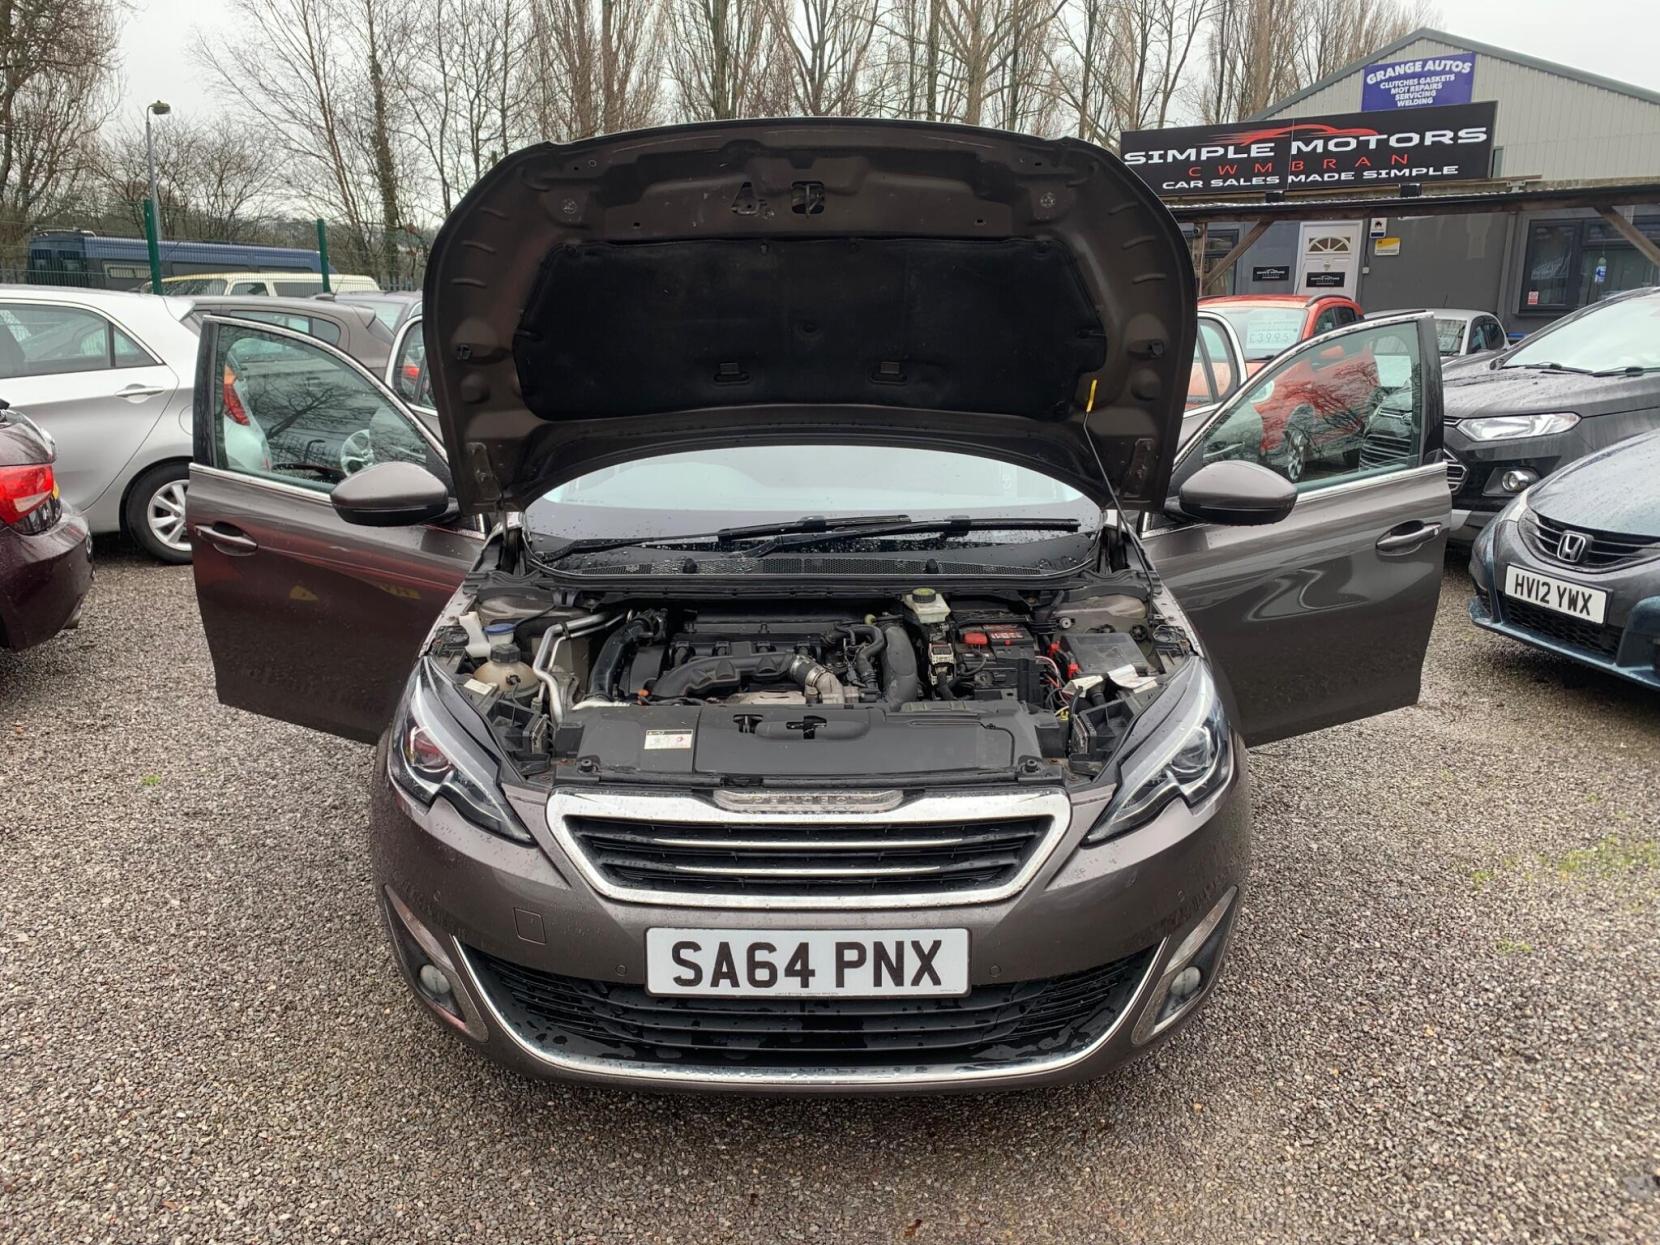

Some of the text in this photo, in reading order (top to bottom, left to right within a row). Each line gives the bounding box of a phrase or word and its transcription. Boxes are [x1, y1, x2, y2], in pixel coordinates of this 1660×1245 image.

[1366, 60, 1472, 84] GRANGE AUTOS
[1380, 73, 1455, 89] CLUTCHES GASKETS
[1391, 82, 1442, 95] MOT REPAIRS
[1395, 90, 1437, 101] SERVICING
[1397, 97, 1433, 107] WELDING
[1124, 127, 1487, 165] SIMPLE MOTORS
[1162, 165, 1459, 190] CAR SALES MADE SIMPLE
[1514, 573, 1593, 616] HV12 YWX
[671, 939, 943, 989] SA64 PNX
